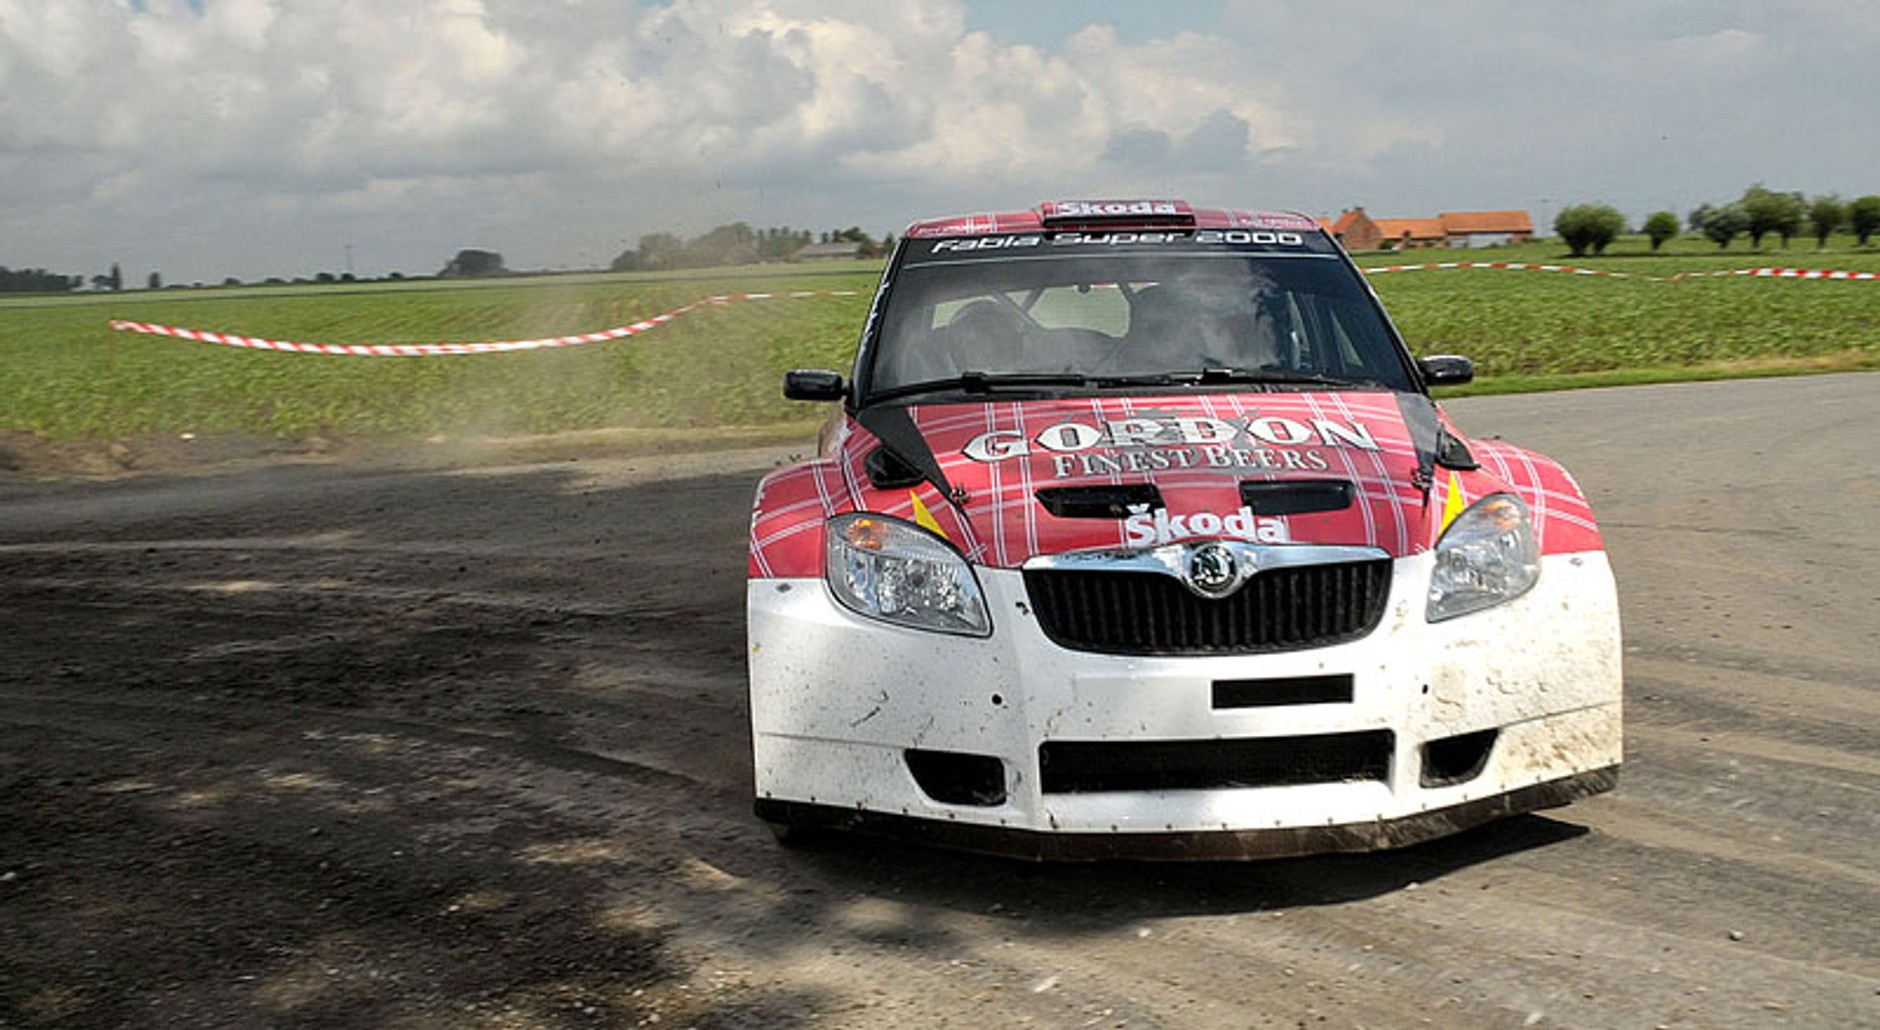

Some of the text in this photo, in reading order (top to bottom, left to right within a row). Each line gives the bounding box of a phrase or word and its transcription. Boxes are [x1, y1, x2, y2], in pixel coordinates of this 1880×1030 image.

[931, 235, 1041, 253] Fabia
[1053, 232, 1186, 245] Super
[1196, 230, 1303, 245] 2000
[963, 417, 1379, 462] GORDON
[1054, 445, 1329, 478] FINEST BEERS
[1126, 503, 1289, 549] Škoda
